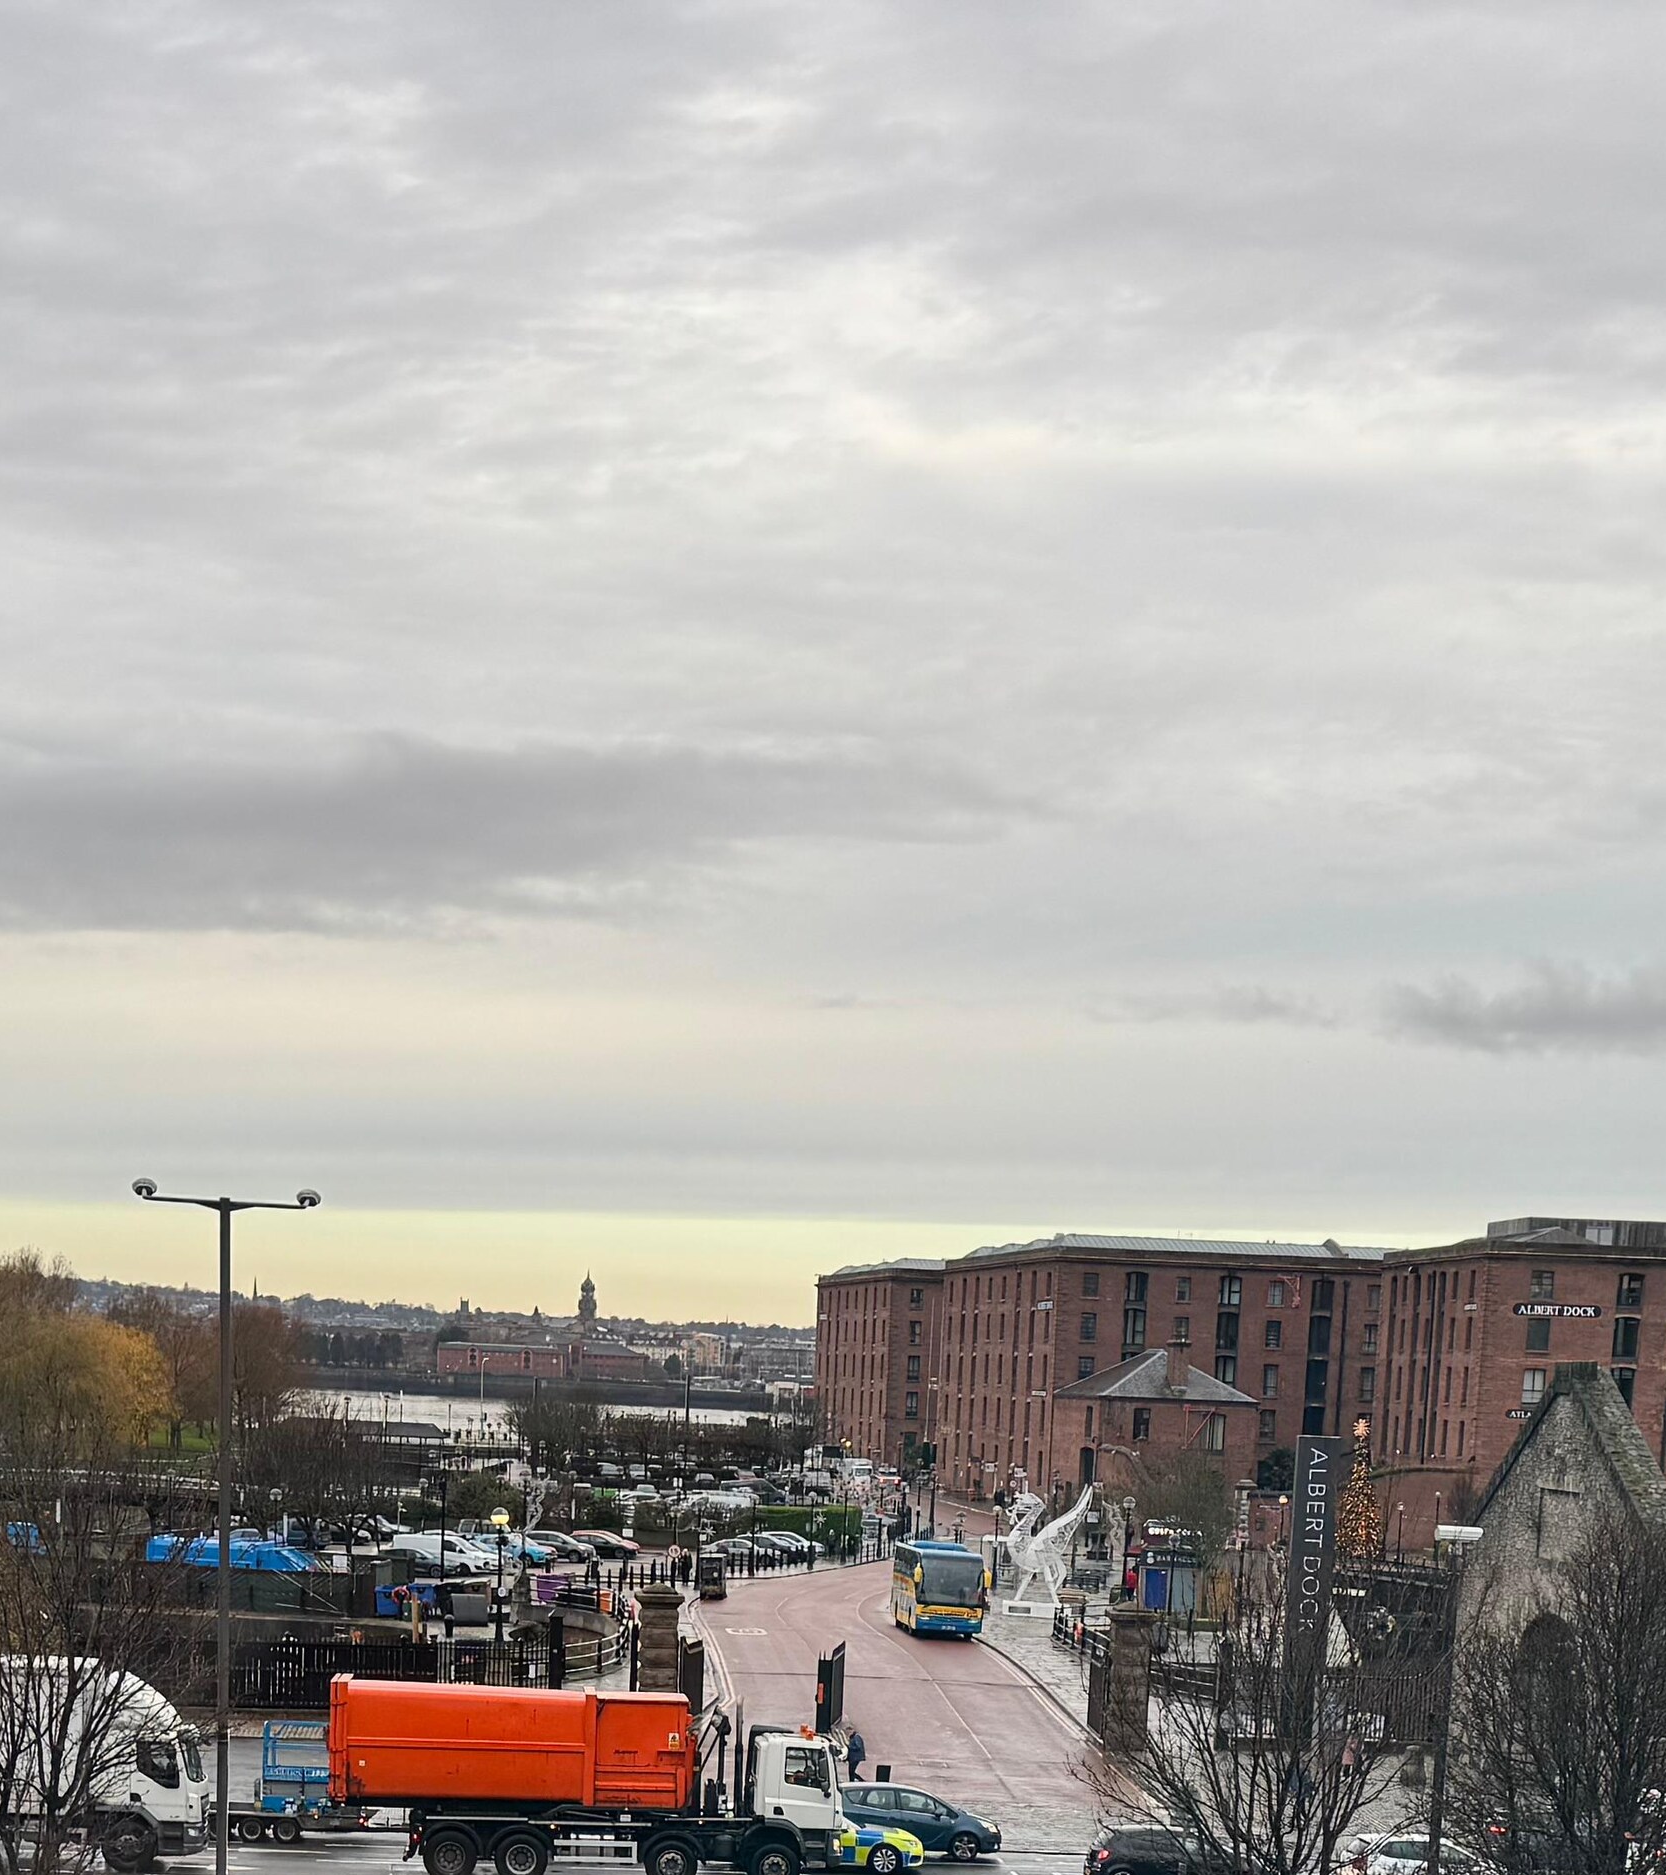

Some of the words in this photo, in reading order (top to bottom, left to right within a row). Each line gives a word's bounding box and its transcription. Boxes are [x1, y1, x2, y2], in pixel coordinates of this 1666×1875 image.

[1518, 1304, 1561, 1316] ALBERT
[1563, 1306, 1596, 1317] DOCK
[1304, 1448, 1329, 1548] ALBERT
[1298, 1556, 1321, 1632] DOCK
